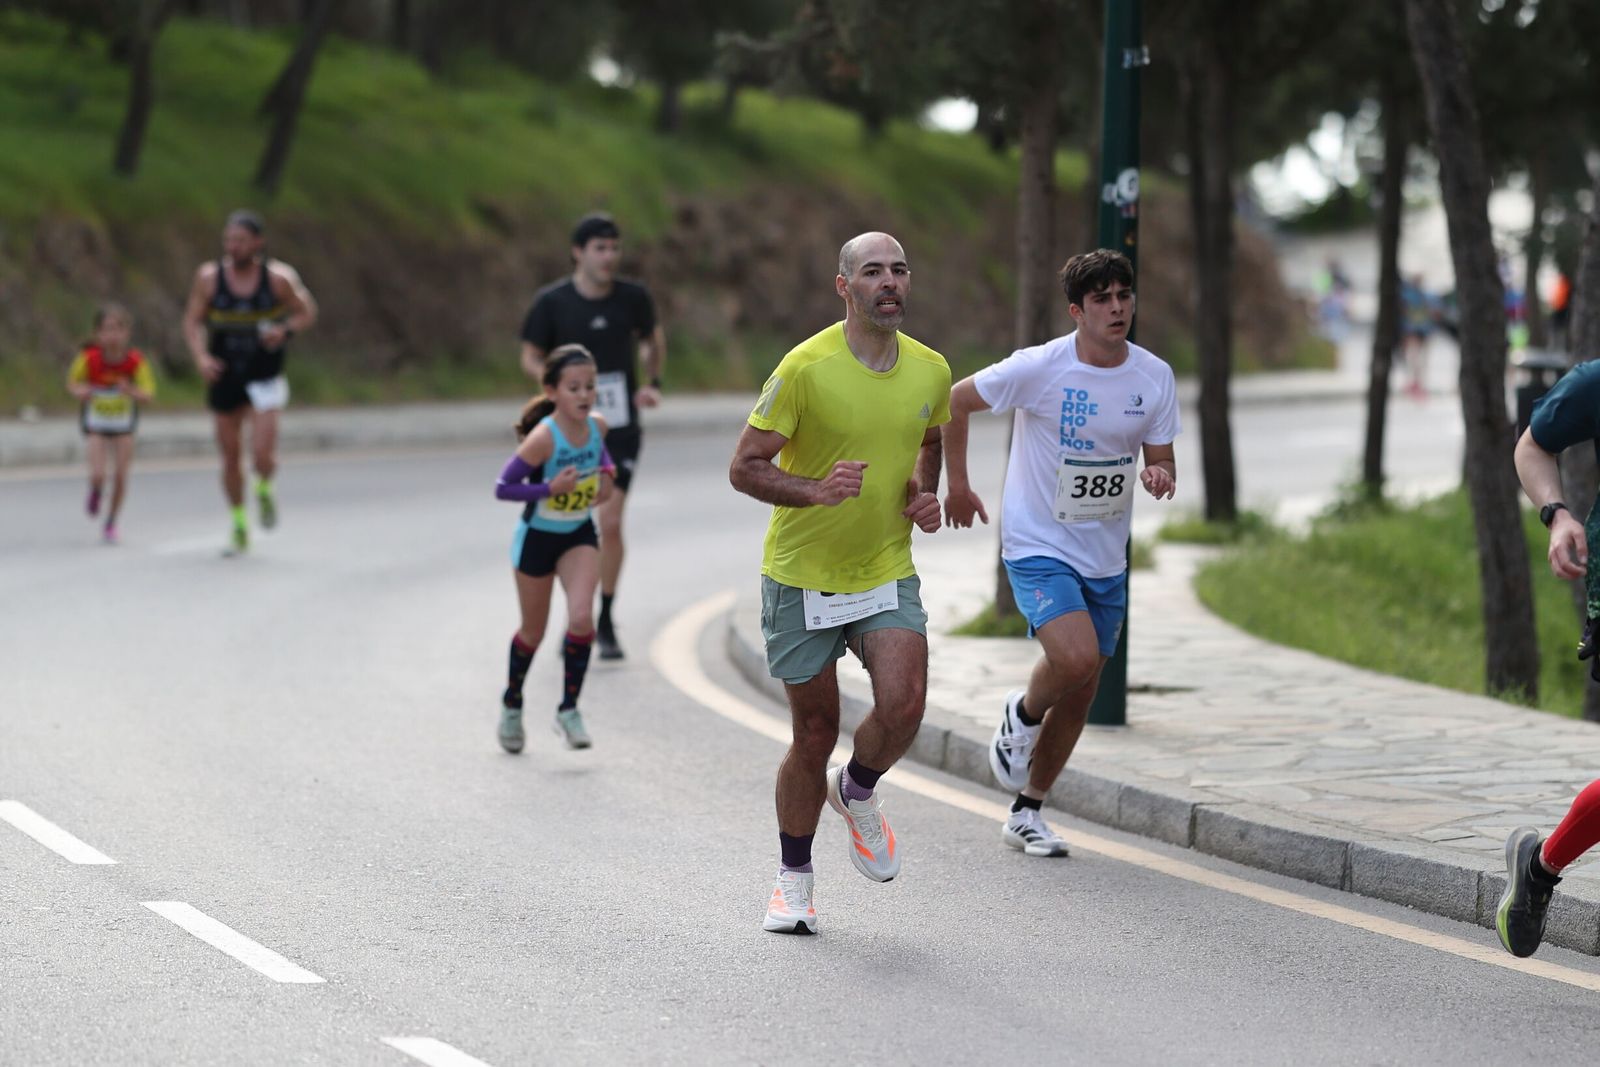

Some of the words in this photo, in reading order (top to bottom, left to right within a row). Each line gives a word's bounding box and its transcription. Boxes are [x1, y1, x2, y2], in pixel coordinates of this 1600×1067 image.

[1063, 388, 1088, 401] TO
[1062, 401, 1098, 416] RRE
[1061, 414, 1087, 427] MO
[1060, 426, 1076, 438] LI
[1060, 437, 1095, 450] NOS
[1071, 474, 1125, 498] 388
